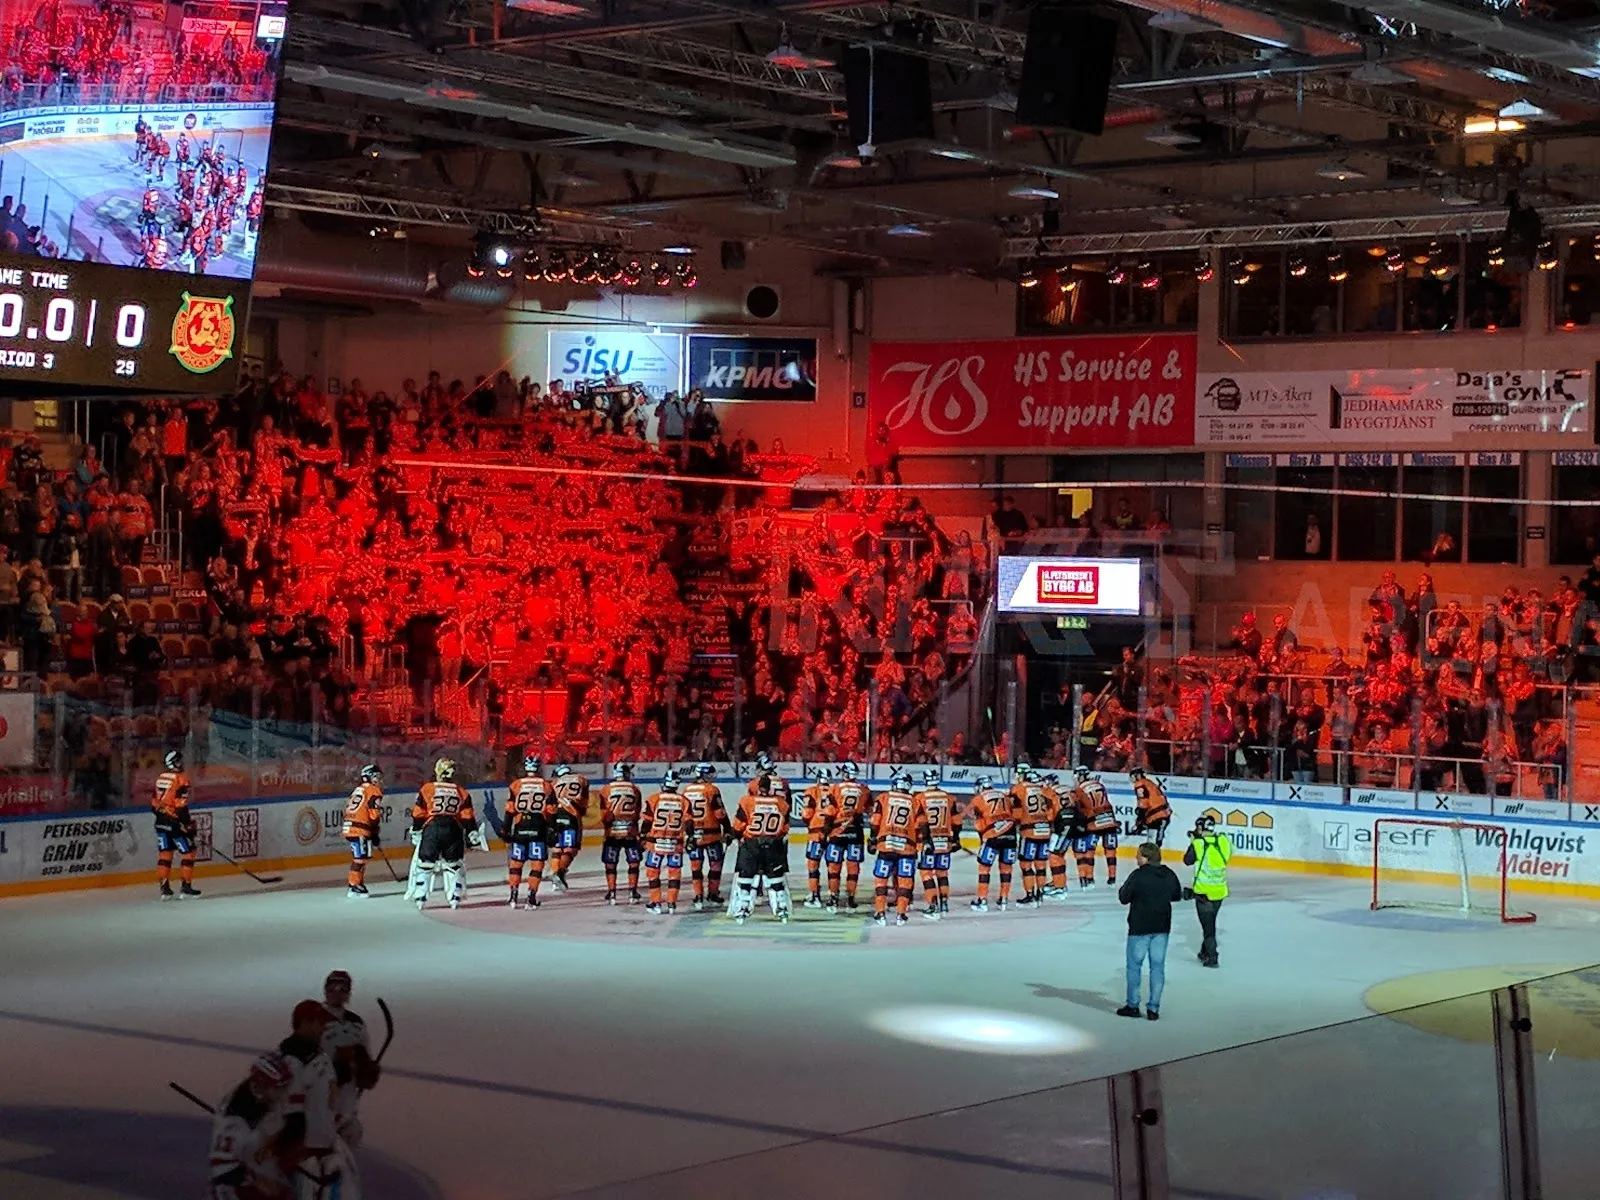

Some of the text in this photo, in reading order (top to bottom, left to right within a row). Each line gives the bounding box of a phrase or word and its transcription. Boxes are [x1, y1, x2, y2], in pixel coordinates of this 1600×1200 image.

[30, 272, 69, 290] TIME
[116, 304, 145, 347] 0
[42, 353, 55, 369] 3
[115, 360, 136, 376] 29
[1014, 350, 1182, 387] HS Service &
[1456, 372, 1522, 390] Daja's
[1503, 387, 1551, 401] GYM
[1018, 393, 1176, 434] Support AB
[1343, 398, 1443, 412] JEDHAMMARS
[1343, 414, 1437, 430] BYGGTJÄNST
[1078, 581, 1095, 594] AB
[555, 781, 581, 800] 79
[431, 795, 460, 814] 38
[517, 791, 546, 811] 68
[610, 794, 636, 813] 72
[986, 797, 1006, 815] 71
[235, 809, 258, 827] SYD
[653, 808, 683, 829] 53
[749, 812, 780, 832] 30
[887, 805, 911, 826] 18
[927, 806, 948, 827] 31
[43, 819, 124, 840] PETERSSONS
[1475, 827, 1587, 855] Wahlqvist
[42, 840, 89, 863] GRÄV
[1496, 851, 1571, 878] Måleri
